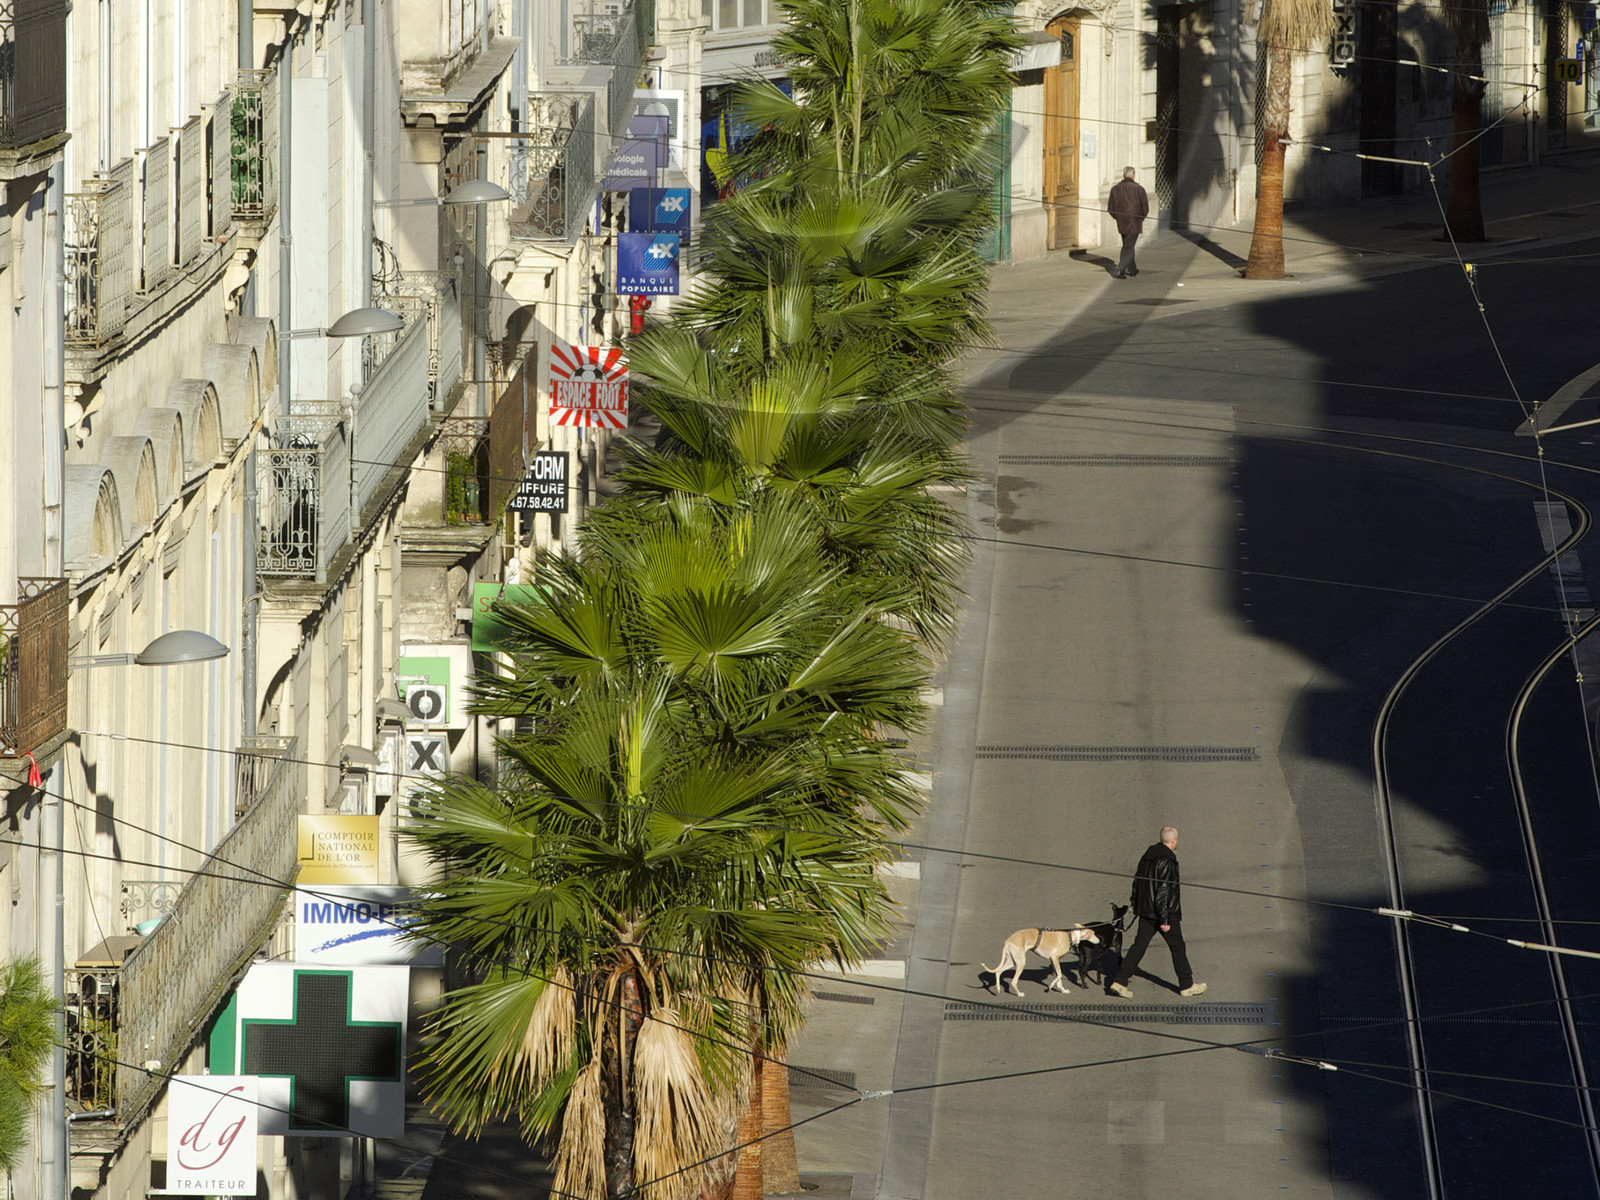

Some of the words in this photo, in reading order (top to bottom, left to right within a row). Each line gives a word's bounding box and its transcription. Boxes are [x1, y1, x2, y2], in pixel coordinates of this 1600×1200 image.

[1557, 64, 1578, 82] 10
[621, 285, 674, 293] POPULAIRE
[557, 382, 592, 408] ESPACE
[596, 384, 621, 409] FOOT
[318, 832, 374, 841] COMPTOIR
[318, 843, 375, 852] NATIONAL
[318, 854, 332, 862] DE
[337, 854, 361, 862] L'OR
[177, 1179, 246, 1190] TRAITEUR
